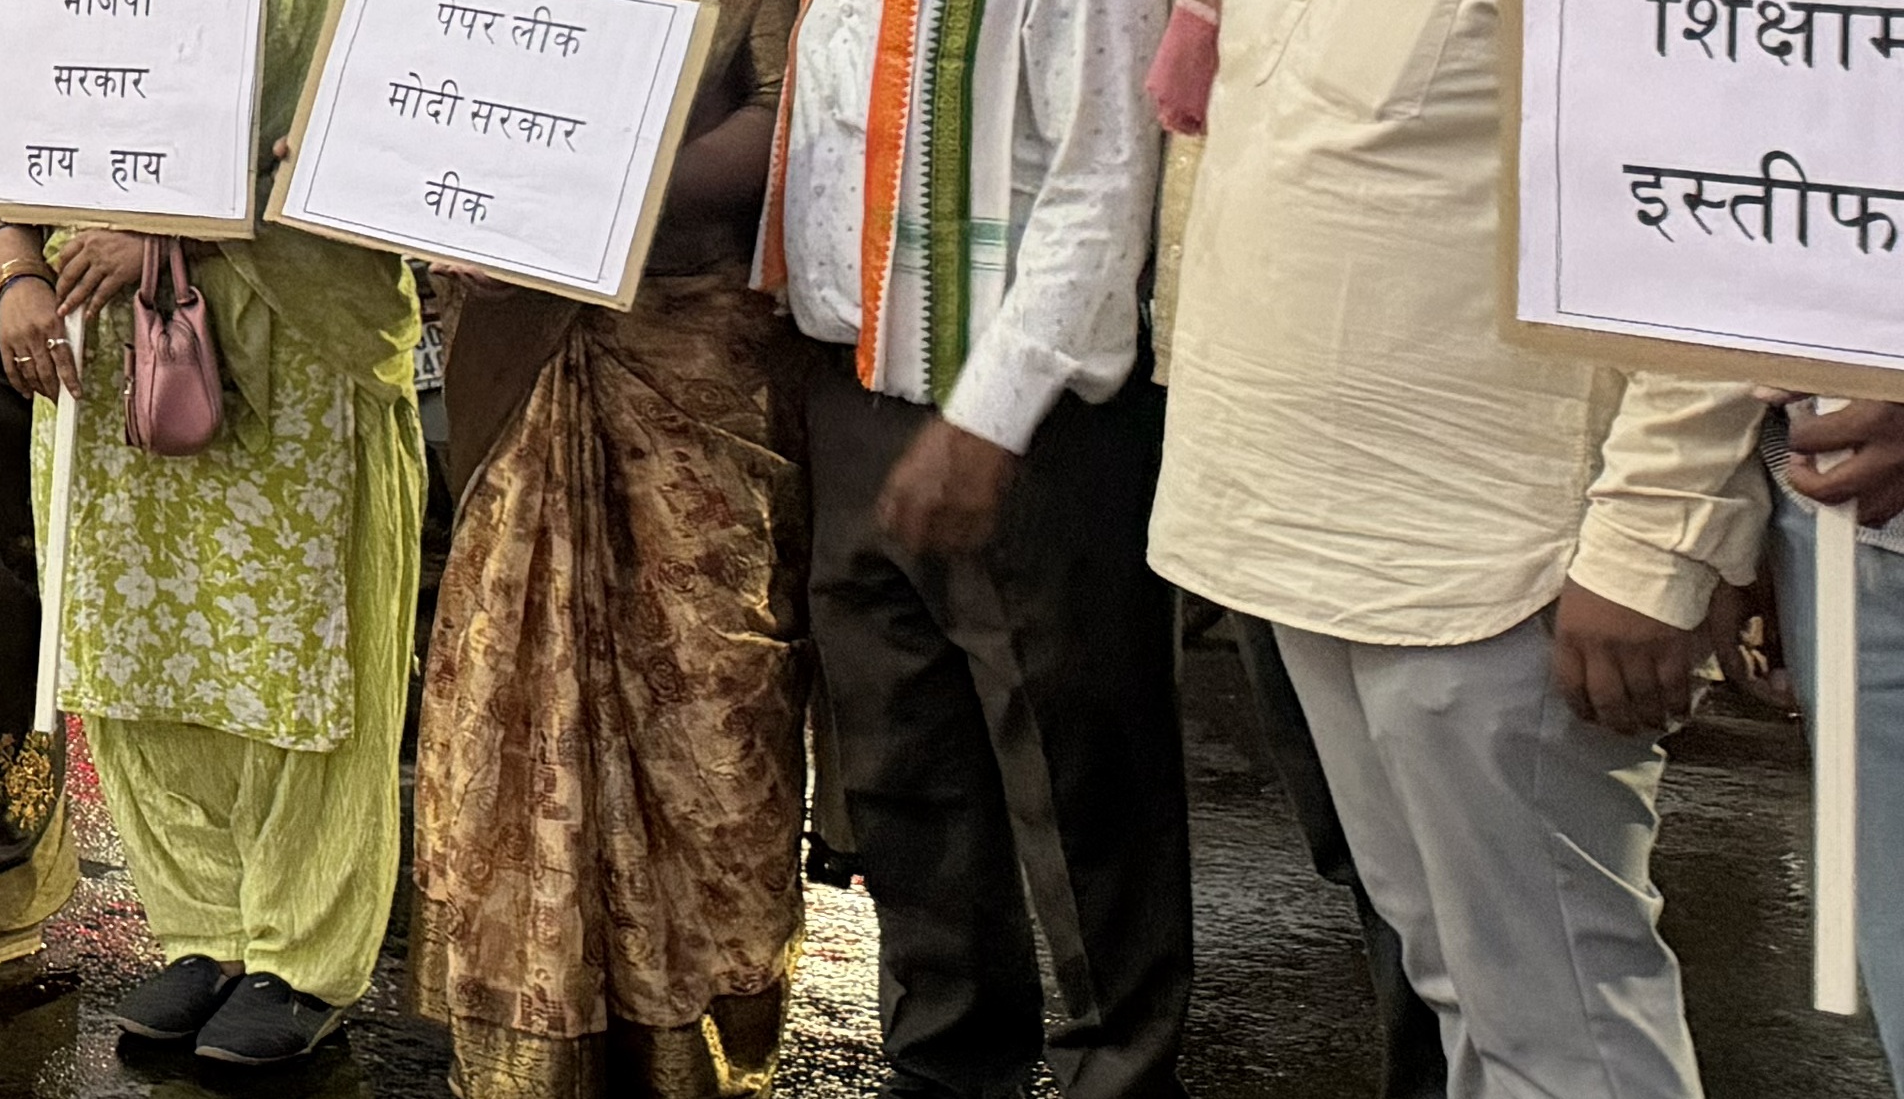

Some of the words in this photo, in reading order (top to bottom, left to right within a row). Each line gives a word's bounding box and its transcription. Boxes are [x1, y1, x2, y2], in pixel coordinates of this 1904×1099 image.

[511, 5, 588, 59] लीक
[53, 65, 150, 99] सरकार
[388, 71, 466, 127] मोदी
[471, 98, 588, 152] सरकार
[25, 145, 79, 186] हाय
[110, 150, 167, 193] हाय
[424, 170, 496, 225] वीक
